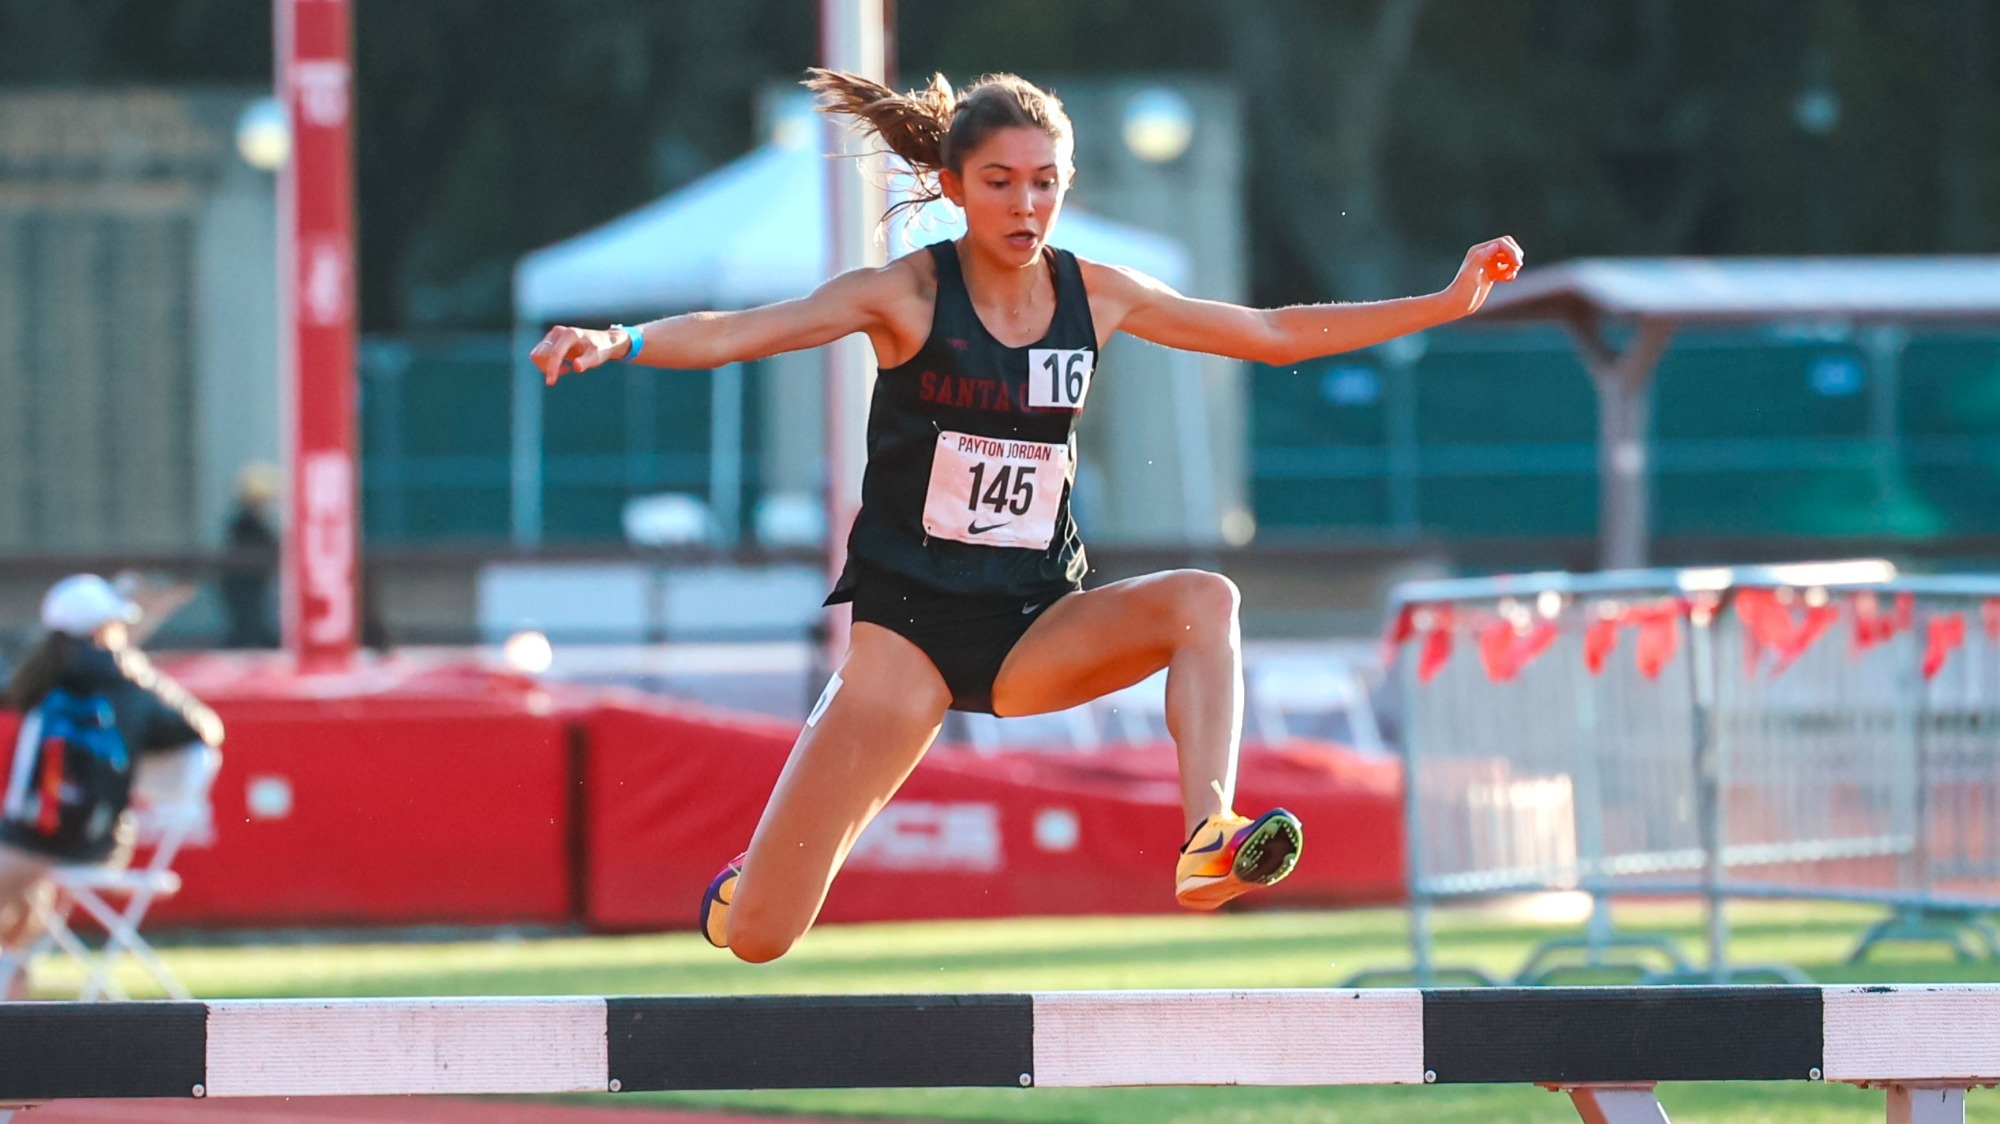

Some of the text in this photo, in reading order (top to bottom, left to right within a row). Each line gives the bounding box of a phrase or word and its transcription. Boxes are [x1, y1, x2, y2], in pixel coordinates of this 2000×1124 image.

[920, 371, 1010, 411] SANTA
[1042, 353, 1084, 404] 16
[958, 436, 1052, 461] PAYTON JORDAN
[968, 462, 1036, 515] 145
